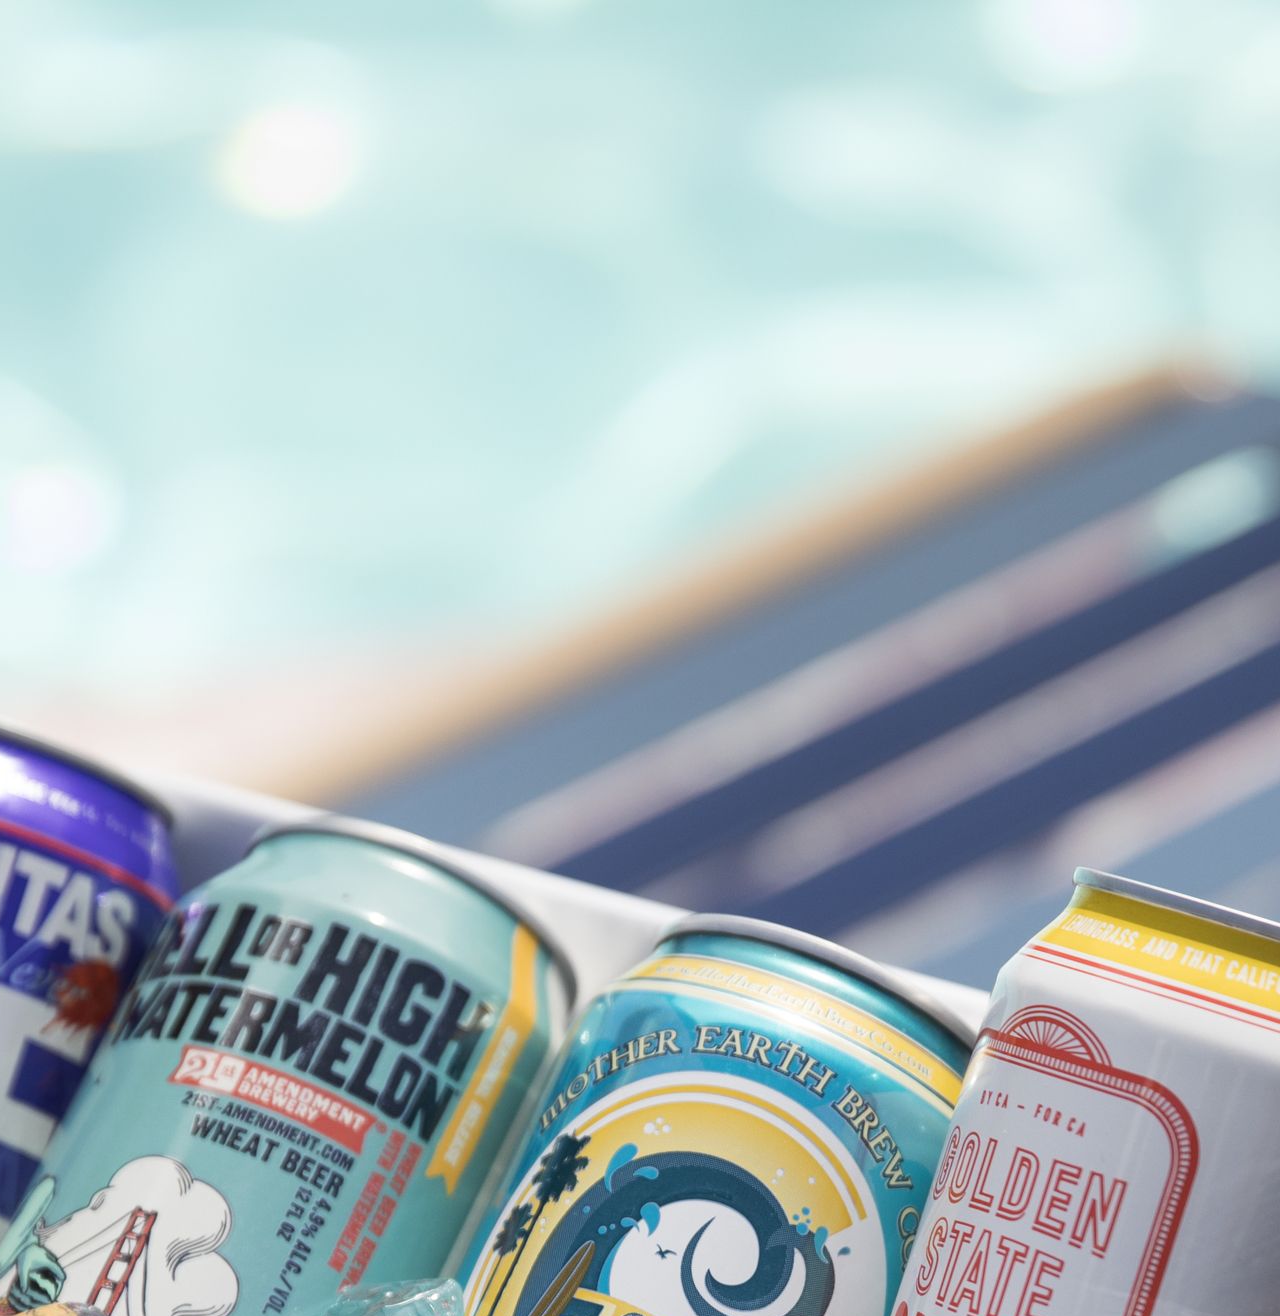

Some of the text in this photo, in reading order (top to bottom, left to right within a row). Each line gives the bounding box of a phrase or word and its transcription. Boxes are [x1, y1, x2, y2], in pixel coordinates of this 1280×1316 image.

[1140, 935, 1175, 962] AND
[1180, 945, 1226, 975] THAT
[247, 914, 314, 967] OR
[296, 921, 494, 1082] HIGH
[110, 979, 458, 1144] WATERMELON
[180, 1089, 356, 1172] 21ST-AMENDMENT.COM
[236, 1079, 320, 1122] BREWERY
[244, 1066, 367, 1133] AMENDMENT
[691, 1024, 839, 1099] EARTH
[830, 1085, 913, 1191] BREW
[994, 1092, 1010, 1111] CA
[1032, 1103, 1063, 1127] FOR
[1065, 1115, 1088, 1139] CA
[190, 1112, 346, 1198] WHEAT BEER
[932, 1124, 1129, 1260] GOLDEN
[276, 1186, 313, 1243] 12 FL OZ
[300, 1197, 333, 1240] 4.9%
[327, 1170, 387, 1274] WATERMELON
[335, 1235, 378, 1295] BREW
